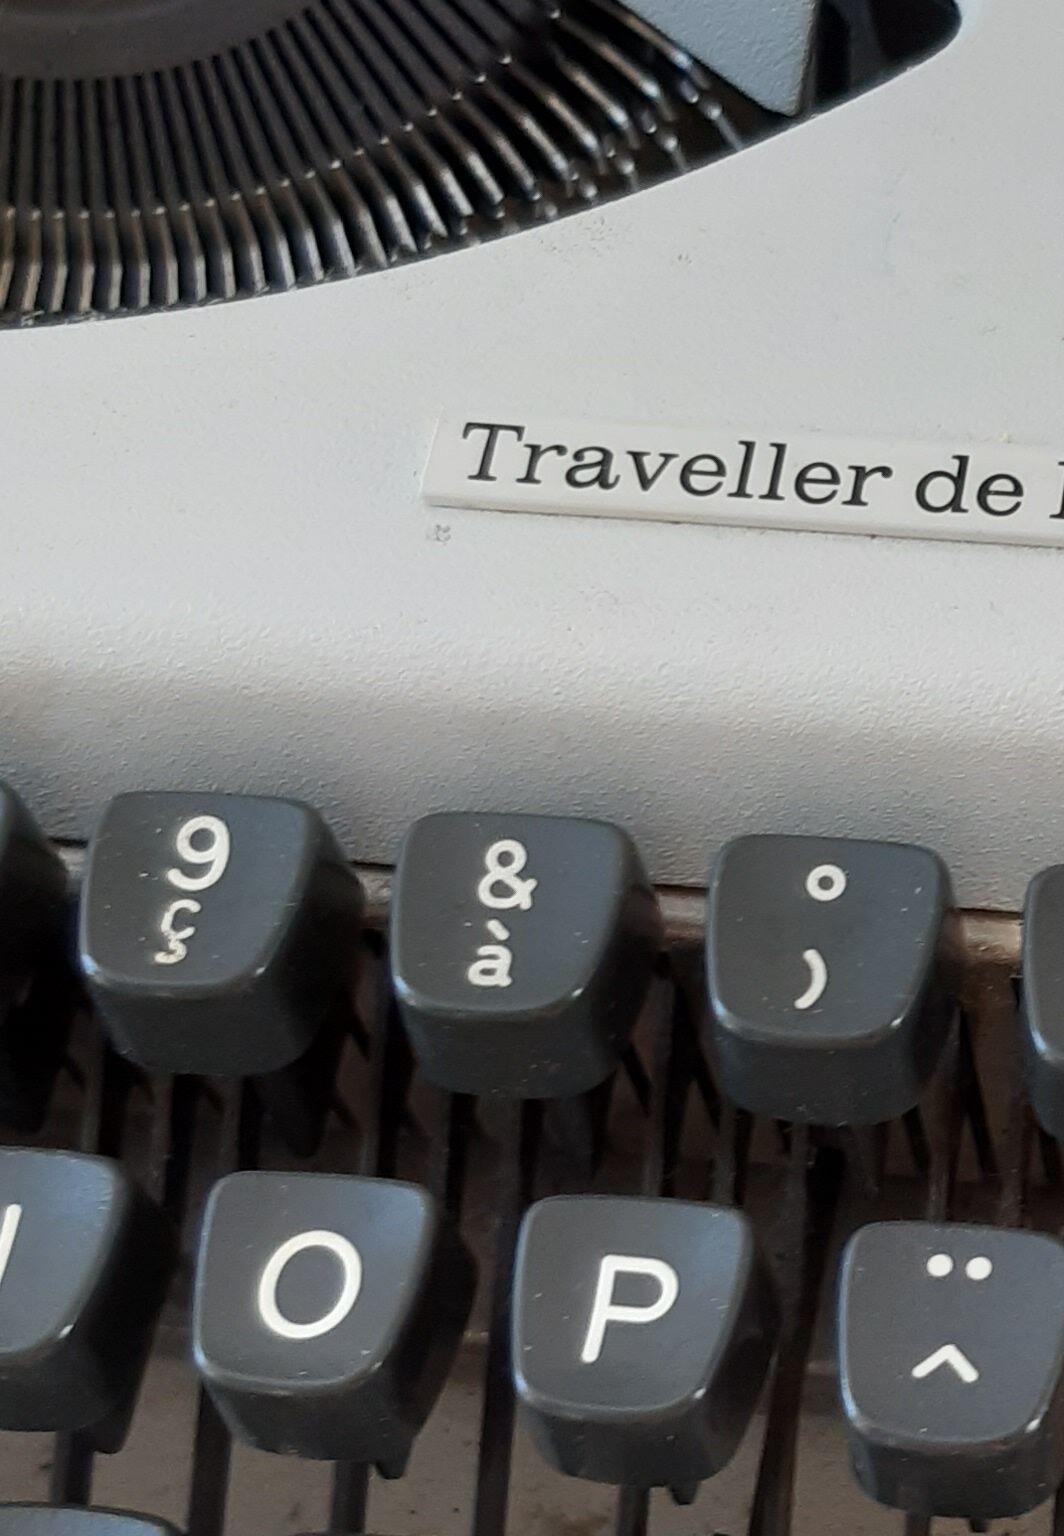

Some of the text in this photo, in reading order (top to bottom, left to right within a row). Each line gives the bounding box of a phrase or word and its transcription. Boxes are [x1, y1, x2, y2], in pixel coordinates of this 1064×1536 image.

[461, 420, 894, 508] Traveller
[914, 453, 1025, 518] de
[166, 814, 231, 892] 9
[476, 838, 538, 911] &
[466, 918, 513, 988] à
[256, 1229, 362, 1340] O
[580, 1253, 679, 1364] P
